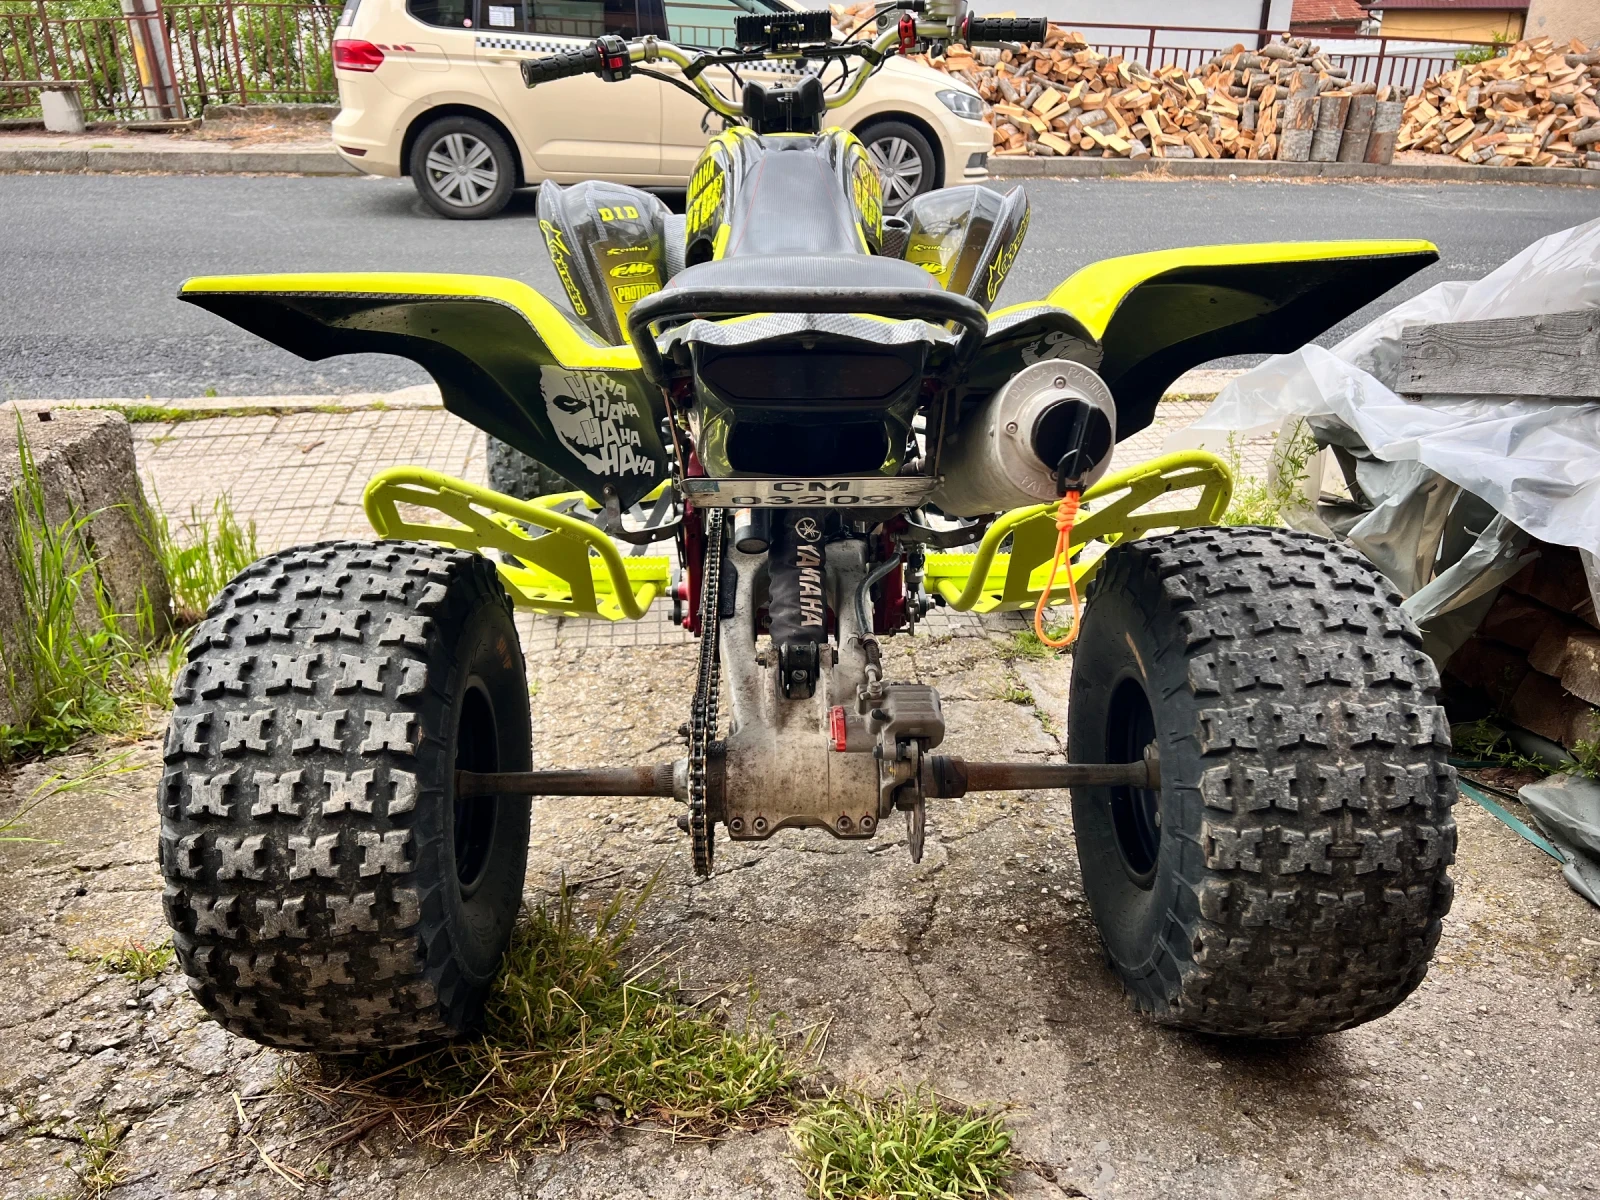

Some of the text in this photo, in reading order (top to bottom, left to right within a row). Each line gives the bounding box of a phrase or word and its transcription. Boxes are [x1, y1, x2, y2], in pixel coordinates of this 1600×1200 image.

[687, 155, 716, 203] AMAHA
[611, 263, 653, 277] FMF
[1008, 365, 1110, 402] DUNCAN RACING
[773, 481, 850, 492] CM
[796, 545, 823, 627] YAMAHA
